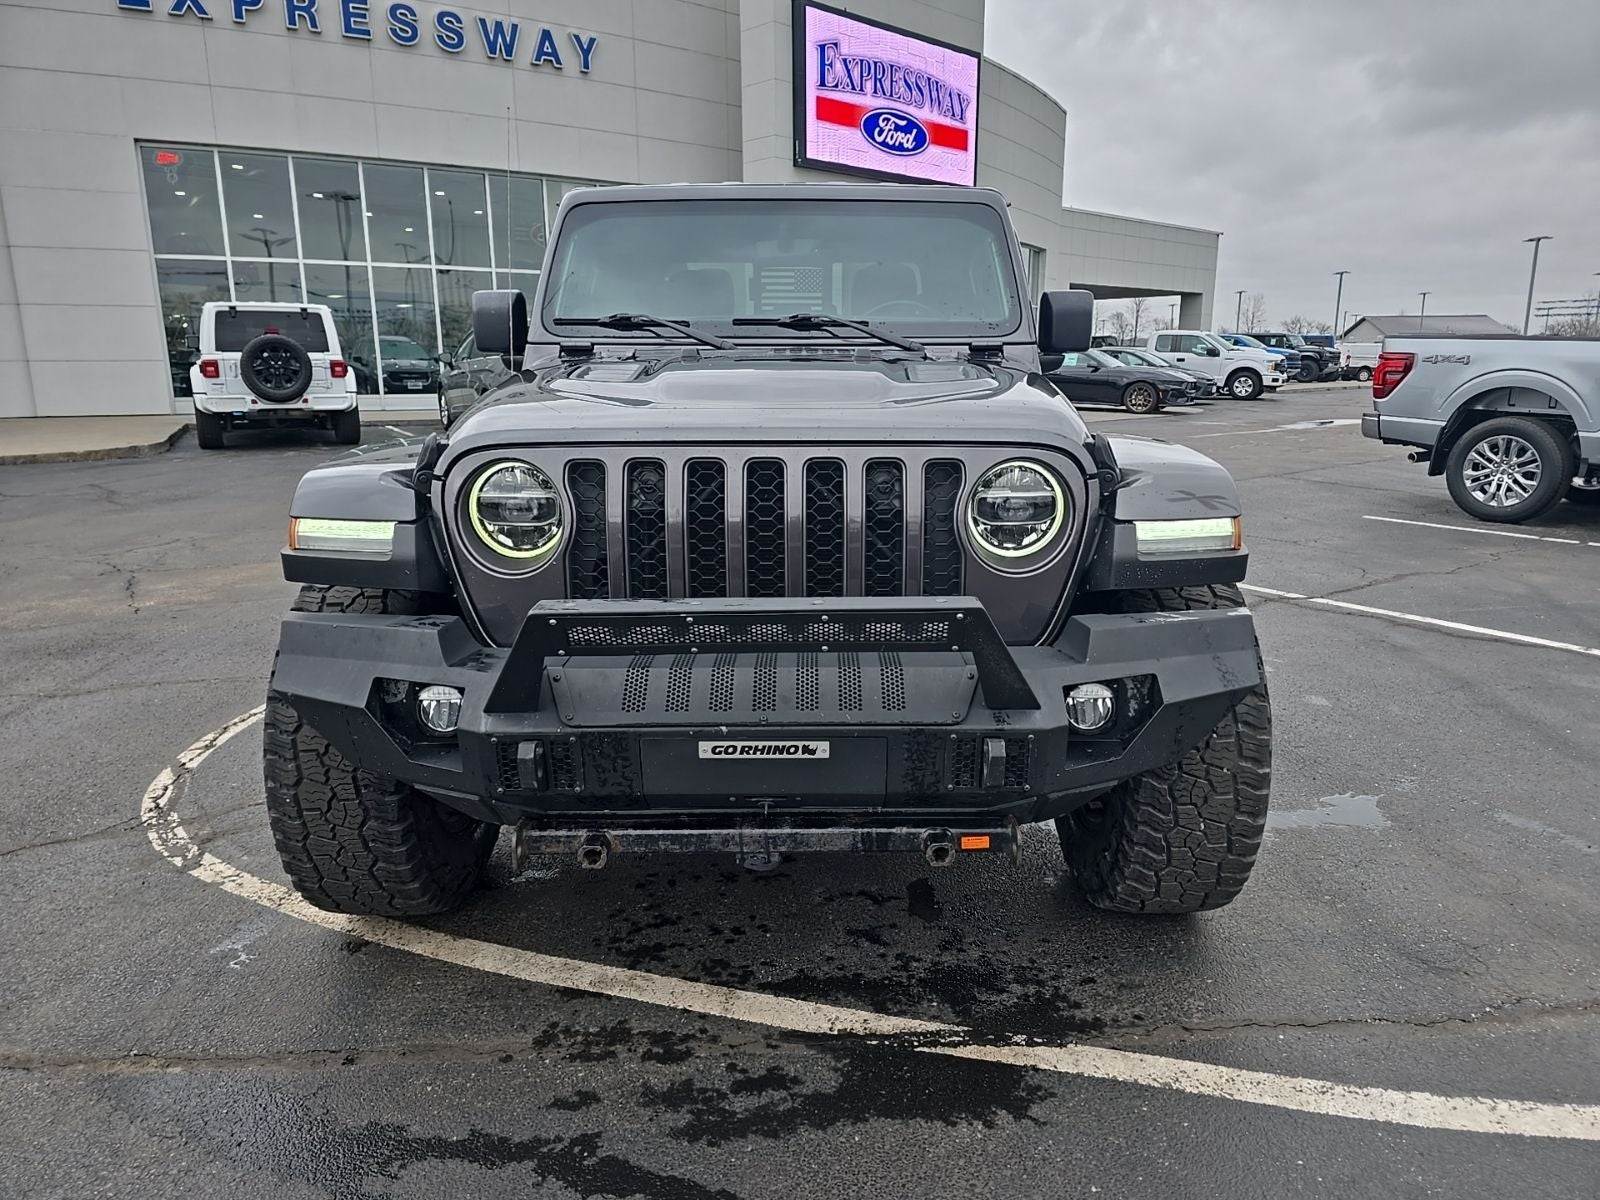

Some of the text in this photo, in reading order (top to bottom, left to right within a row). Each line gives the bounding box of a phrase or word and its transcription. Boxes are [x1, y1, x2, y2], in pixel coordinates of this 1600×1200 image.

[117, 0, 598, 73] PRESSWAY
[816, 41, 970, 124] EXPRESSWAY
[873, 113, 917, 149] Ford
